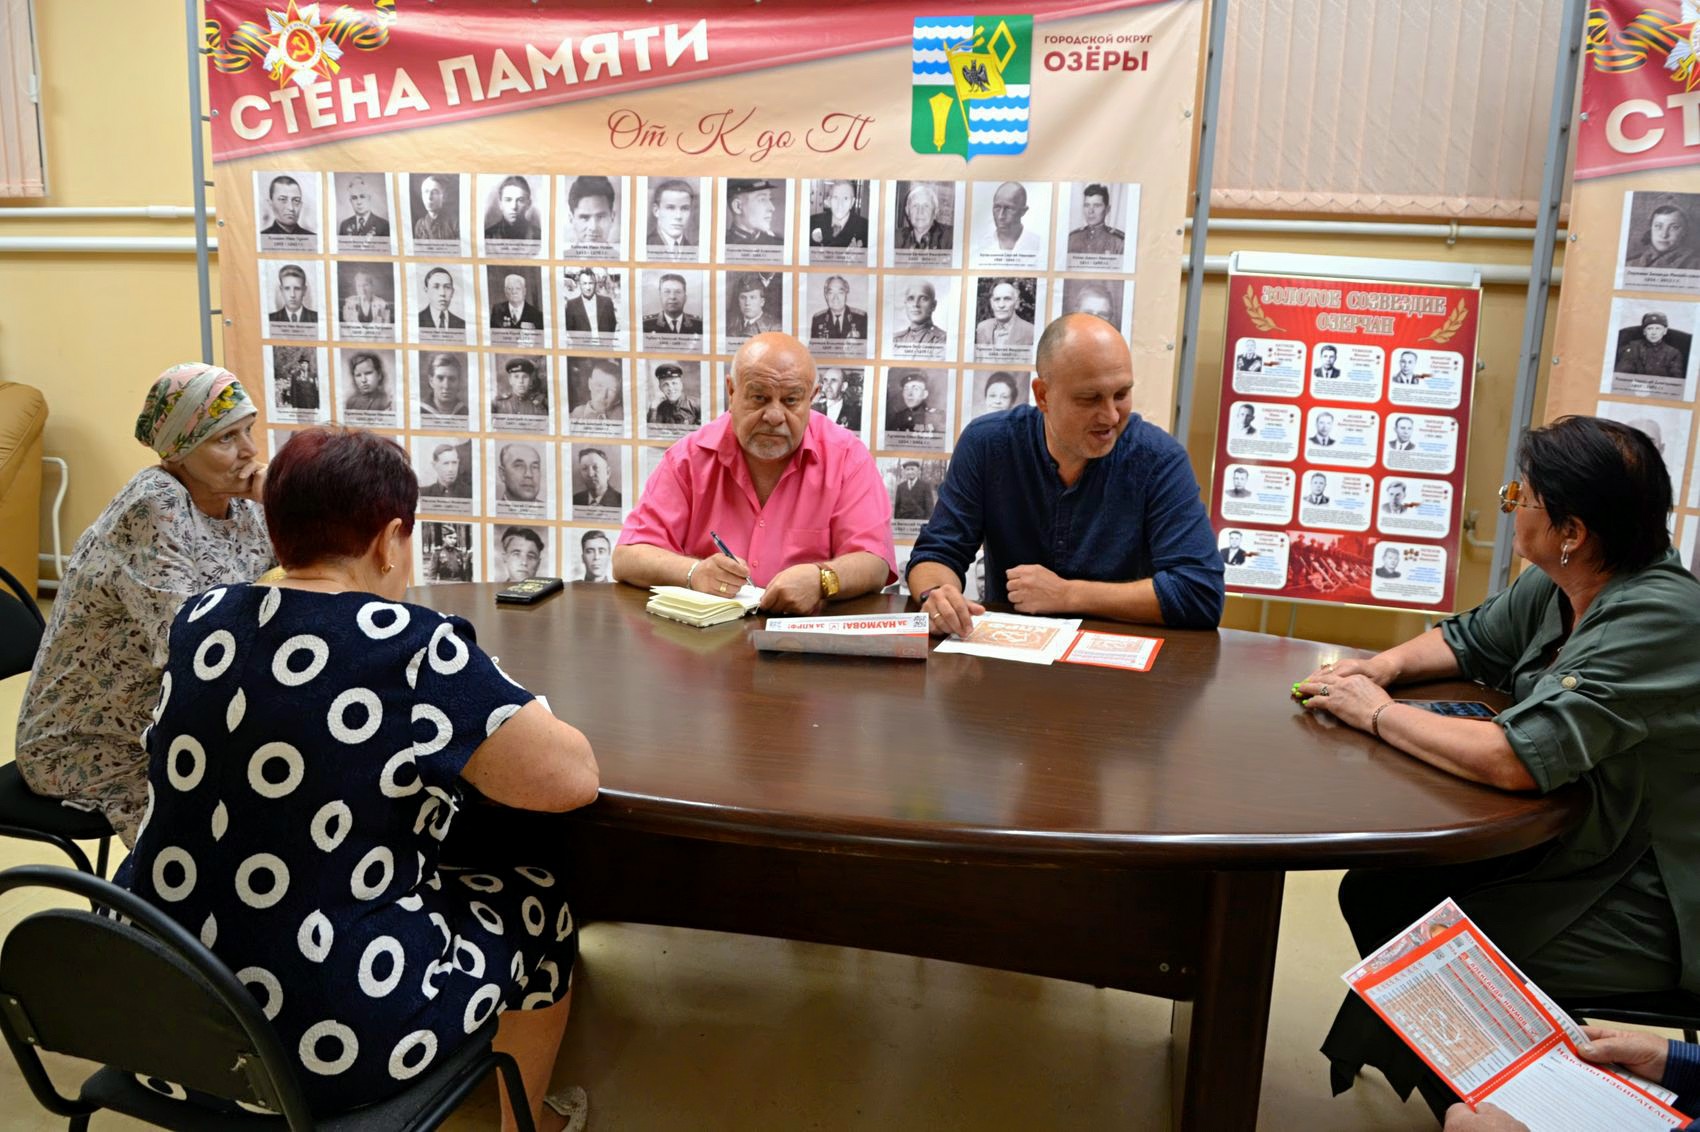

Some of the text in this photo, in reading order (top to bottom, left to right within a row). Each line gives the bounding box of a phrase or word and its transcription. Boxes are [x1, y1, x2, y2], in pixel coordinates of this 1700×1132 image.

[1044, 34, 1153, 44] ГОРОДСКОЙ ОКРУГ
[1044, 45, 1149, 71] ОЗЁРЫ
[230, 18, 709, 141] СТЕНА ПАМЯТИ
[607, 107, 876, 162] От К до П
[1261, 285, 1447, 318] ЗОЛОТОЕ СОЗВЕЗДИЕ
[1316, 312, 1396, 336] ОЗЕРЧАН
[842, 620, 897, 630] НАУМОВА!
